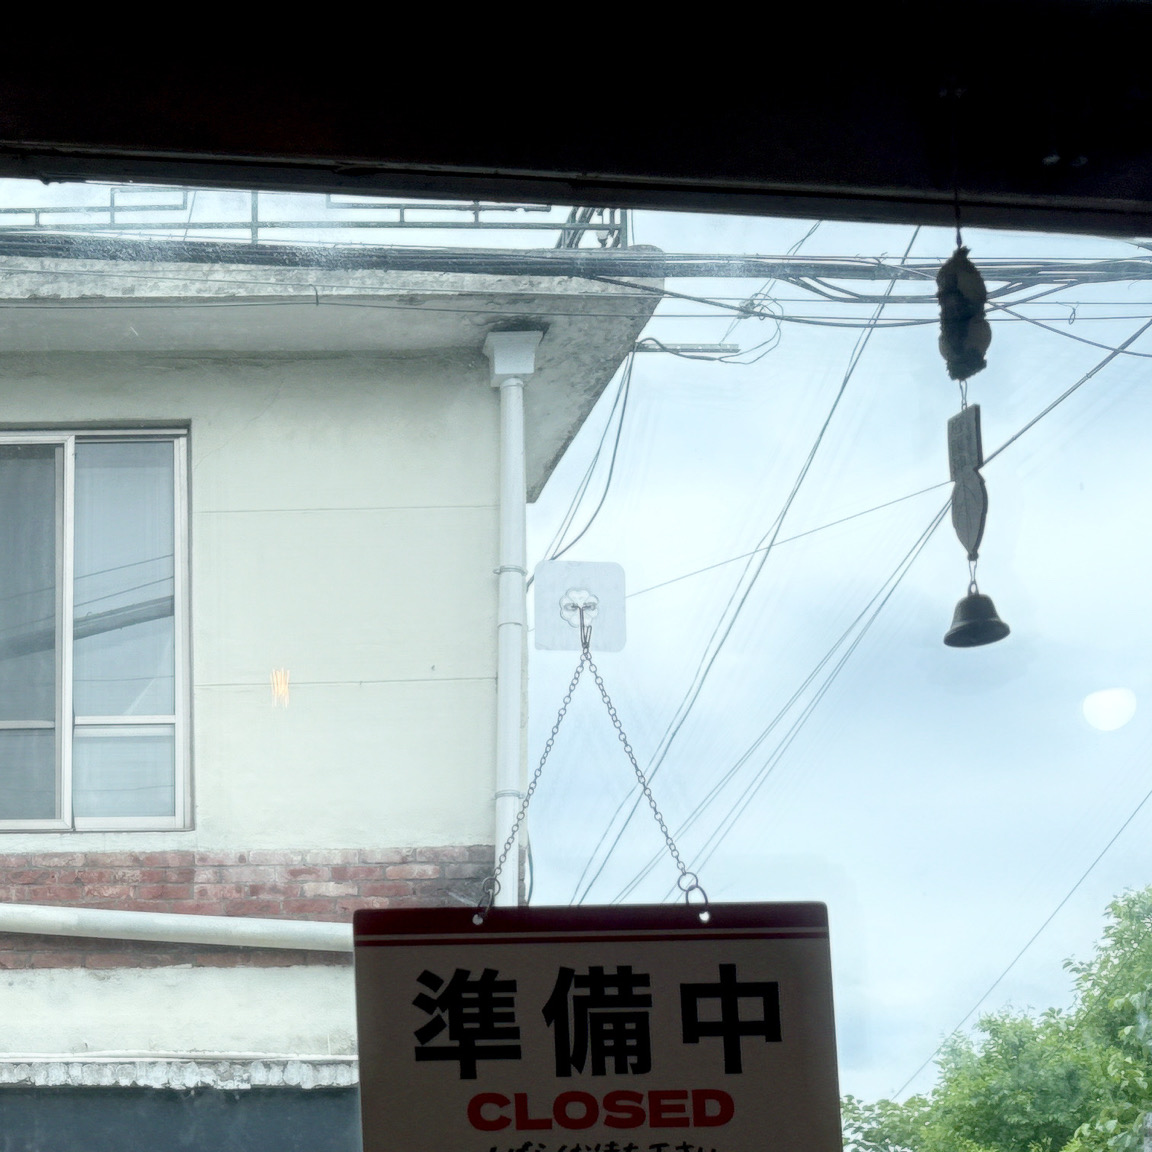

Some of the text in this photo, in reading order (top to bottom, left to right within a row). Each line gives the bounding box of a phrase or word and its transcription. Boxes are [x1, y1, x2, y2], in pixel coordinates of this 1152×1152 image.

[412, 963, 783, 1080] 準備中
[467, 1089, 735, 1132] CLOSED
